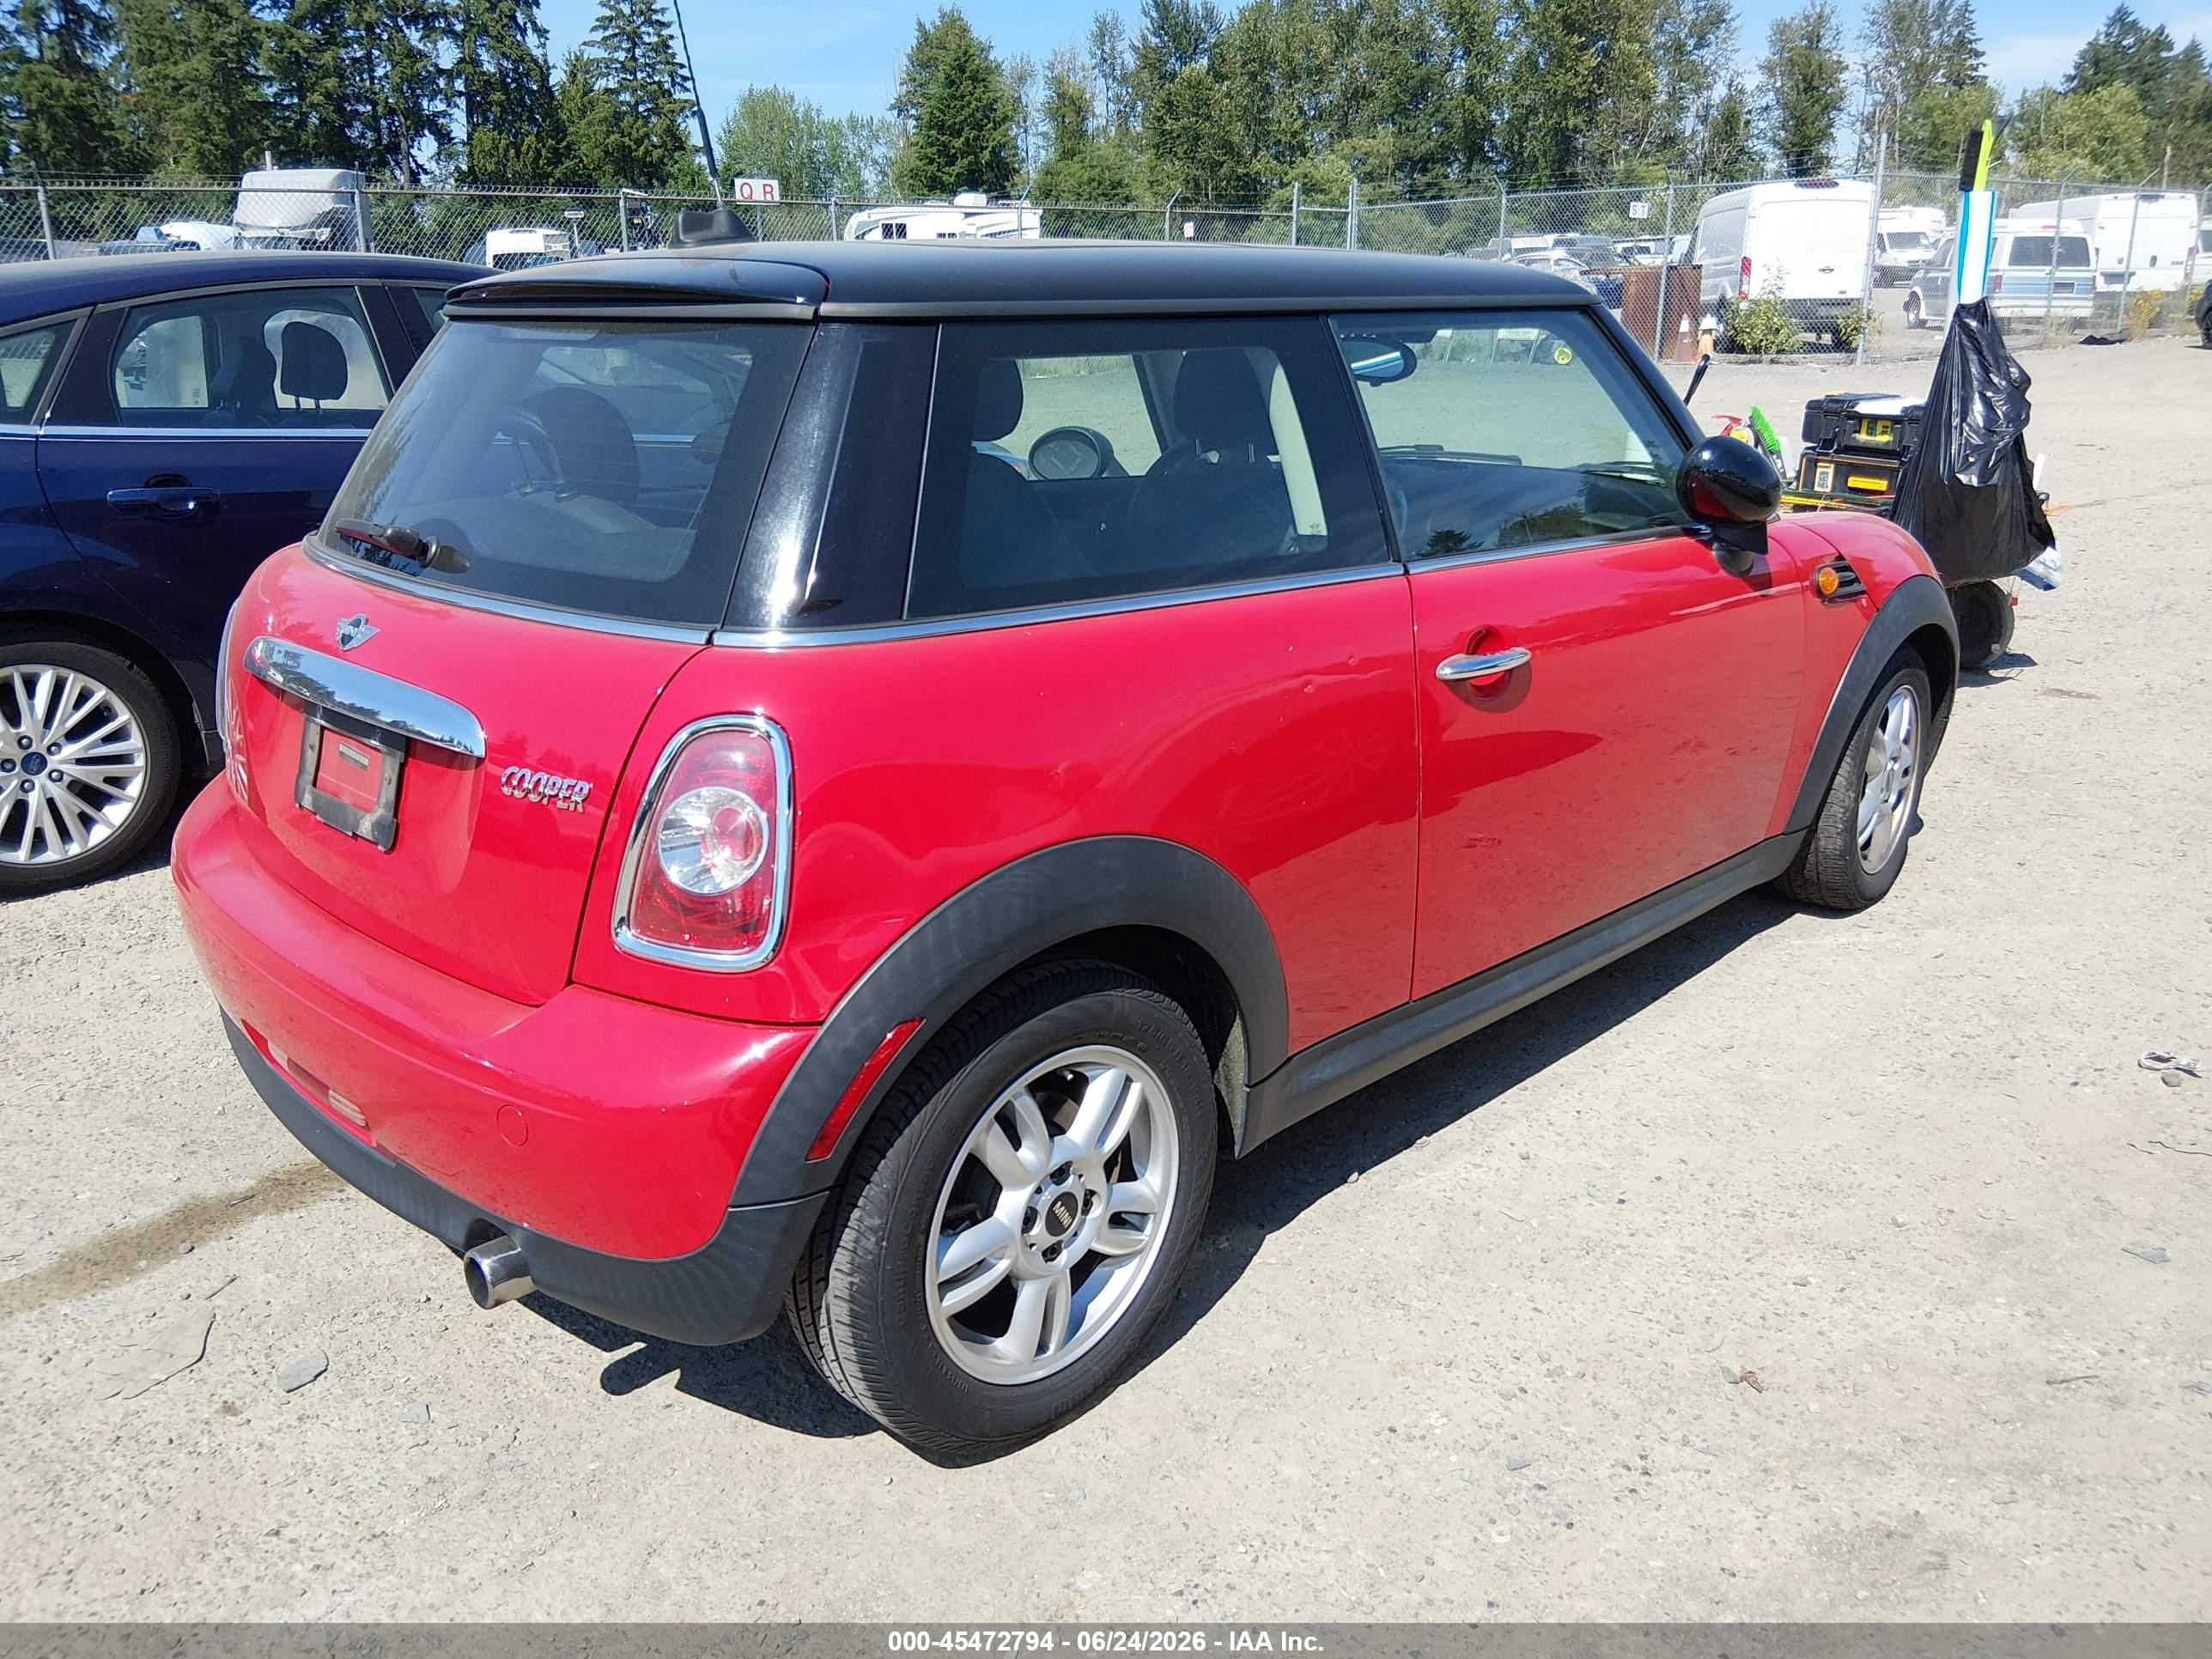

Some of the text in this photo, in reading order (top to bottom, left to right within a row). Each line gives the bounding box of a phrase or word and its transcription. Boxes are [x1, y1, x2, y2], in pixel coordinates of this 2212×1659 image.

[739, 181, 775, 200] Q R
[501, 766, 590, 812] COOPER
[1052, 1200, 1073, 1229] MINI
